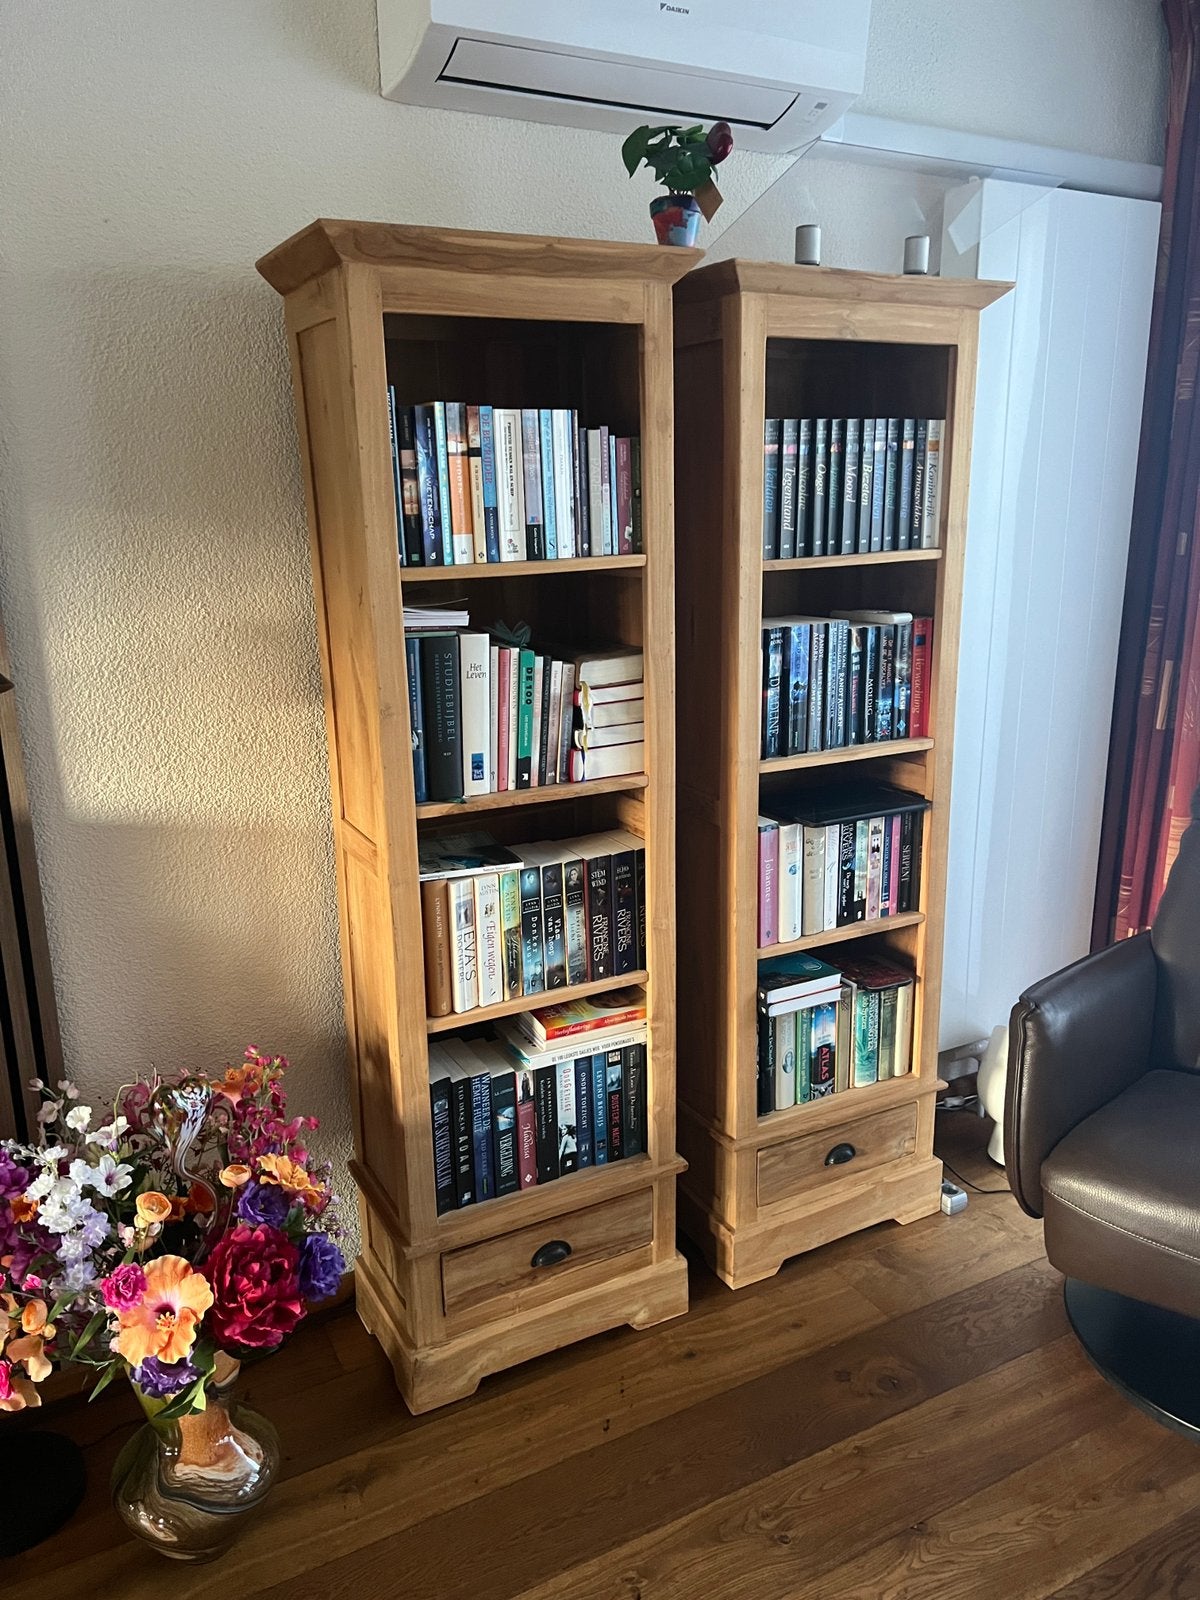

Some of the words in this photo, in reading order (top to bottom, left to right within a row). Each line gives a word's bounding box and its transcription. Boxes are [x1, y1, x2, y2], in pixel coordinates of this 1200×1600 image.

[666, 6, 690, 15] DAIKIN
[481, 413, 489, 427] DE
[482, 430, 493, 485] BEVRIJDER
[765, 466, 778, 514] Verlaten
[799, 465, 810, 510] Nicolae
[815, 463, 828, 497] Oogst
[846, 463, 857, 503] Moord
[861, 463, 873, 506] Bezeten
[873, 463, 885, 520] Merkteken
[913, 462, 924, 528] Armageddon
[926, 463, 937, 519] Koninkrijk
[426, 477, 436, 539] WETENSCHAP
[782, 467, 797, 531] Tegenstand
[466, 671, 487, 679] Leven
[470, 663, 482, 671] Het
[526, 667, 534, 681] DE
[443, 652, 456, 743] STUDIEBIJBEL
[525, 685, 533, 705] 100
[898, 686, 907, 710] CRASH
[911, 657, 925, 715] Verwachting
[768, 677, 781, 738] DEADLINE
[842, 825, 851, 861] RIVERS
[764, 858, 774, 902] Johannes
[901, 844, 912, 882] SERPENT
[483, 921, 497, 948] Eigen
[548, 936, 556, 956] hoop
[593, 914, 604, 962] RIVERS
[617, 908, 628, 953] RIVERS
[624, 910, 632, 946] FRANCINE
[463, 930, 477, 981] EVA'S
[483, 949, 497, 980] wegen
[821, 1047, 830, 1081] ATLAS
[472, 1077, 481, 1109] HEMEL
[481, 1073, 491, 1117] WANNEER
[580, 1072, 588, 1096] ONDER
[596, 1070, 604, 1100] LEVEND
[434, 1111, 450, 1126] DE
[473, 1109, 483, 1134] HUILT
[483, 1119, 491, 1132] DE
[597, 1101, 605, 1128] BEWIJS
[611, 1094, 620, 1125] DUISTERE
[458, 1135, 470, 1174] ADAM
[499, 1133, 514, 1179] VERGELDING
[521, 1122, 534, 1160] Hadassa
[612, 1128, 621, 1147] NACHT
[436, 1126, 452, 1190] SCHEIDSLIJN
